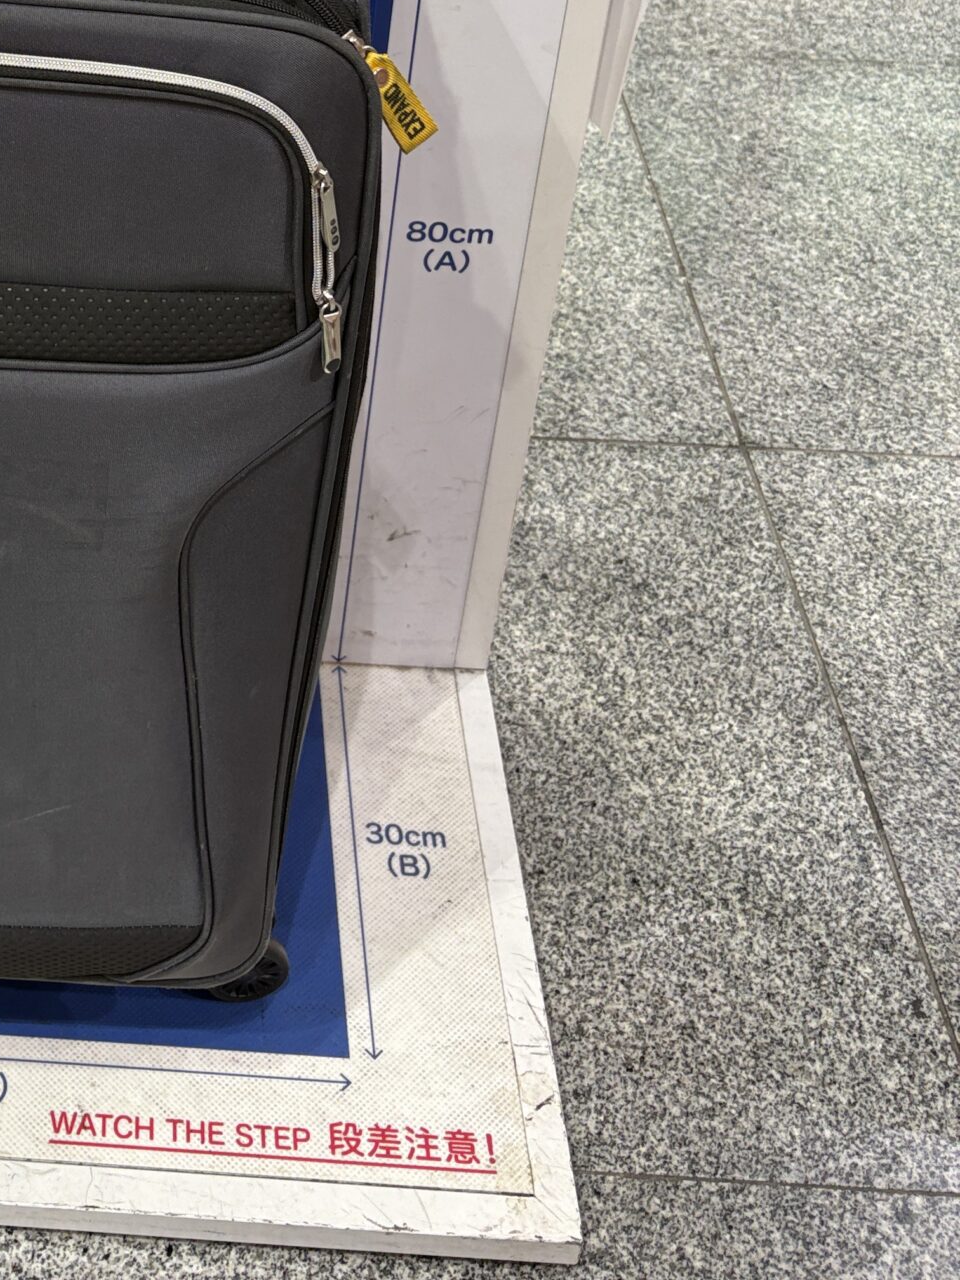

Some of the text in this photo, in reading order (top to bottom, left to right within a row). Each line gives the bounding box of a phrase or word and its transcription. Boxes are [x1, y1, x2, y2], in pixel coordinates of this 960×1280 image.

[383, 83, 426, 141] EXPAND
[406, 220, 494, 245] 80cm
[423, 248, 470, 274] (A)
[365, 822, 447, 848] 30cm
[387, 851, 431, 879] (B)
[48, 1109, 155, 1141] WATCH
[166, 1118, 225, 1145] THE
[235, 1123, 311, 1150] STEP
